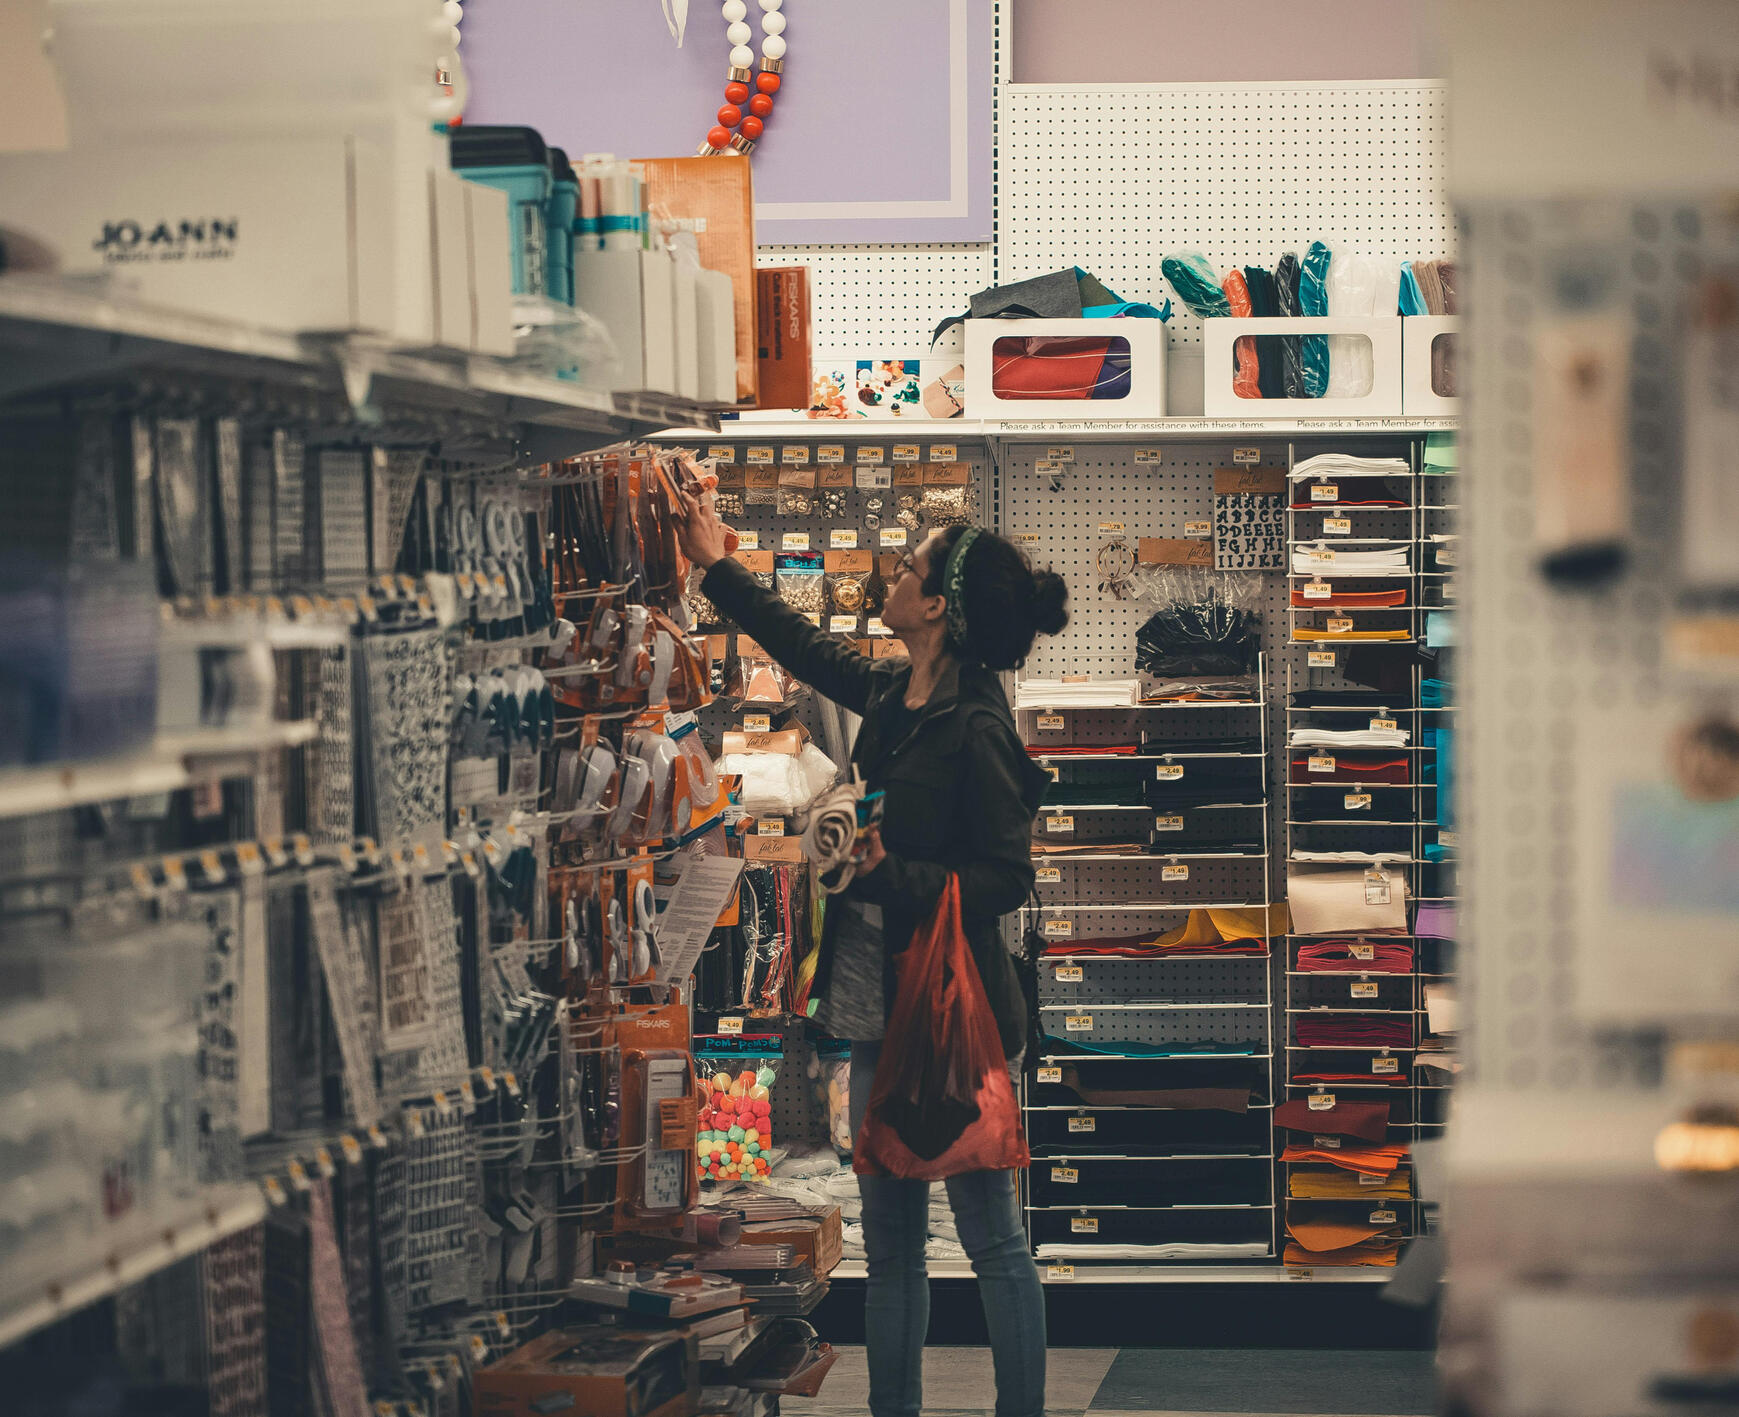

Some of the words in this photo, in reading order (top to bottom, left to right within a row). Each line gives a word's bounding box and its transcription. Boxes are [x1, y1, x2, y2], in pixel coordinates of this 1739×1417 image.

[92, 219, 238, 250] JOANN
[788, 272, 800, 339] FISKARS
[1000, 421, 1029, 430] Please
[1031, 421, 1048, 430] ask
[1057, 421, 1081, 430] Team
[1084, 421, 1124, 430] Member
[1125, 421, 1138, 430] for
[1141, 421, 1187, 430] assistance
[1189, 420, 1209, 430] with
[1212, 420, 1237, 429] these
[1297, 419, 1326, 428] Please
[1328, 419, 1343, 428] ask
[1354, 419, 1379, 428] Team
[1381, 418, 1421, 428] Member
[1423, 418, 1436, 427] for
[636, 1019, 671, 1029] FISKARS
